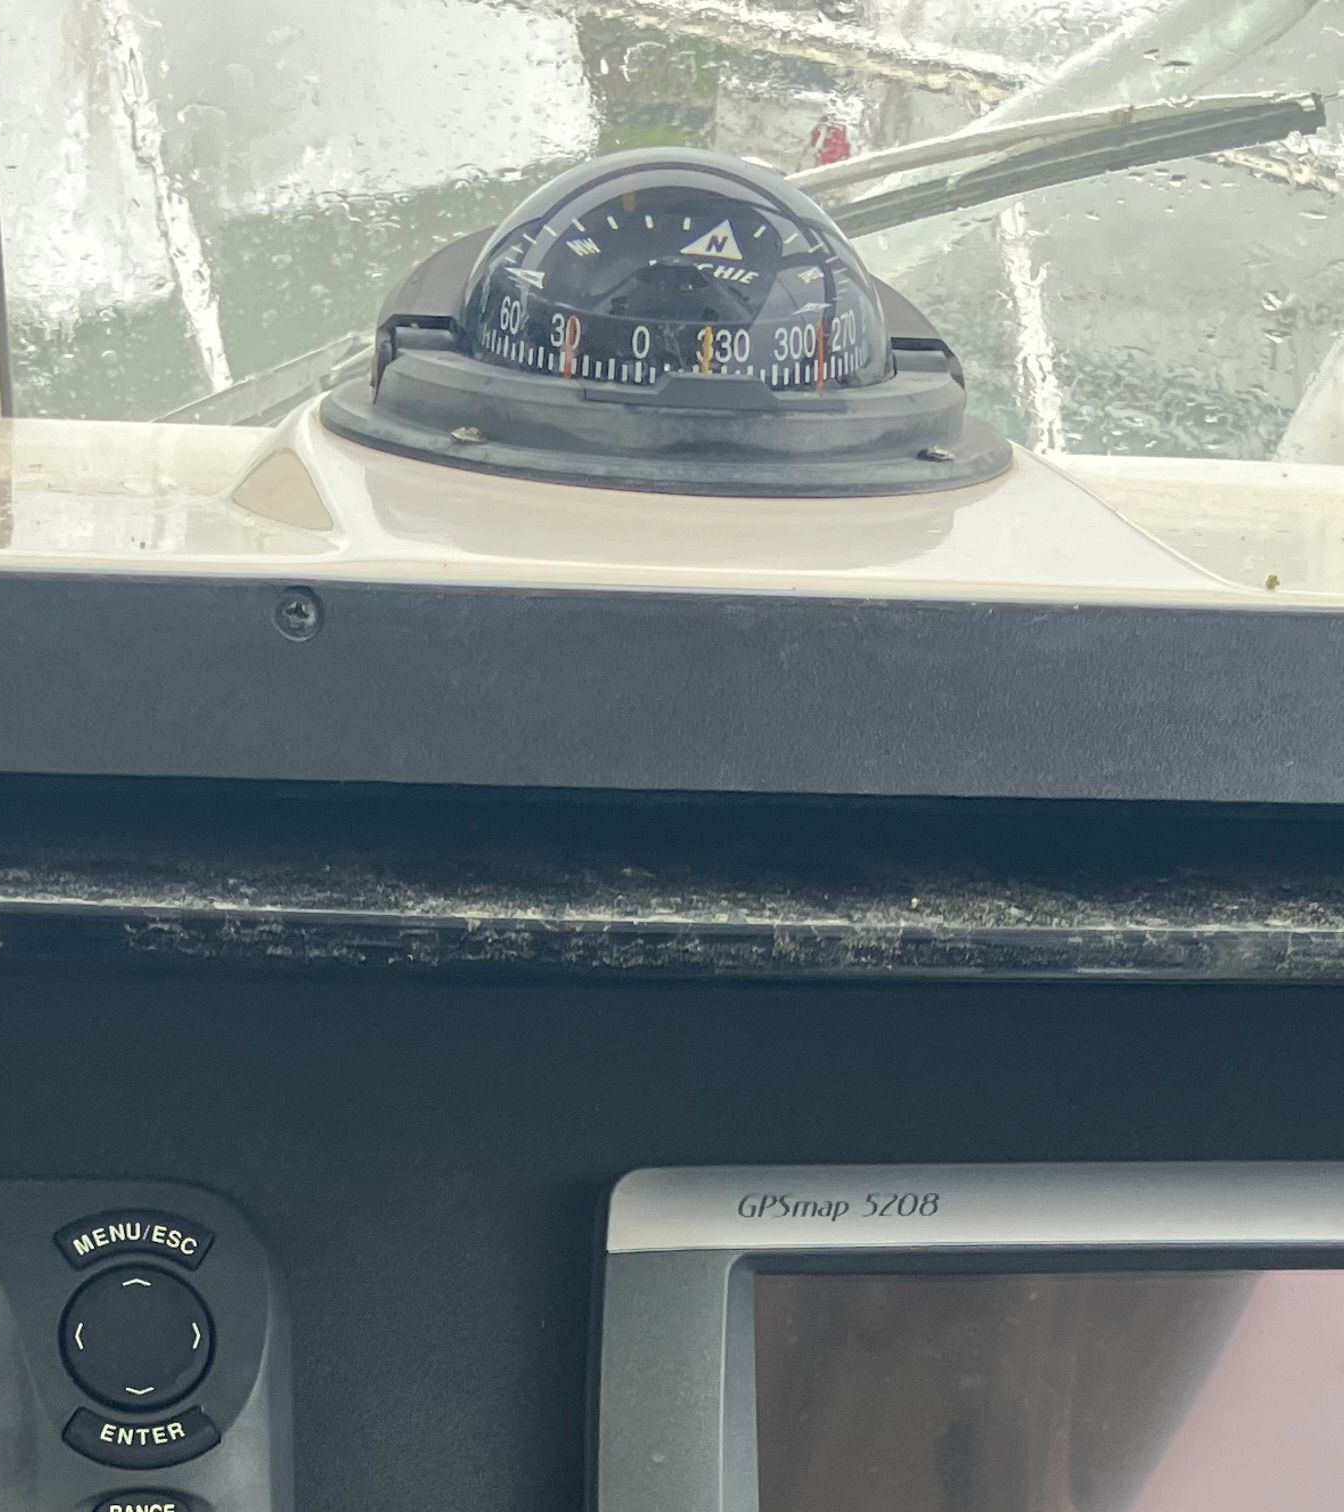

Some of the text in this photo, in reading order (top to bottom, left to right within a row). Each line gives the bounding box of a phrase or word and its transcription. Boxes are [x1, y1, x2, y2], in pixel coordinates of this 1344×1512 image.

[705, 235, 729, 253] N
[500, 296, 521, 335] 60
[550, 313, 582, 350] 30
[831, 310, 857, 351] 270
[631, 325, 651, 359] 0
[773, 324, 816, 361] 300
[737, 1192, 940, 1222] GPSmap 5208
[72, 1221, 199, 1256] MENU/ESC
[100, 1421, 186, 1446] ENTER
